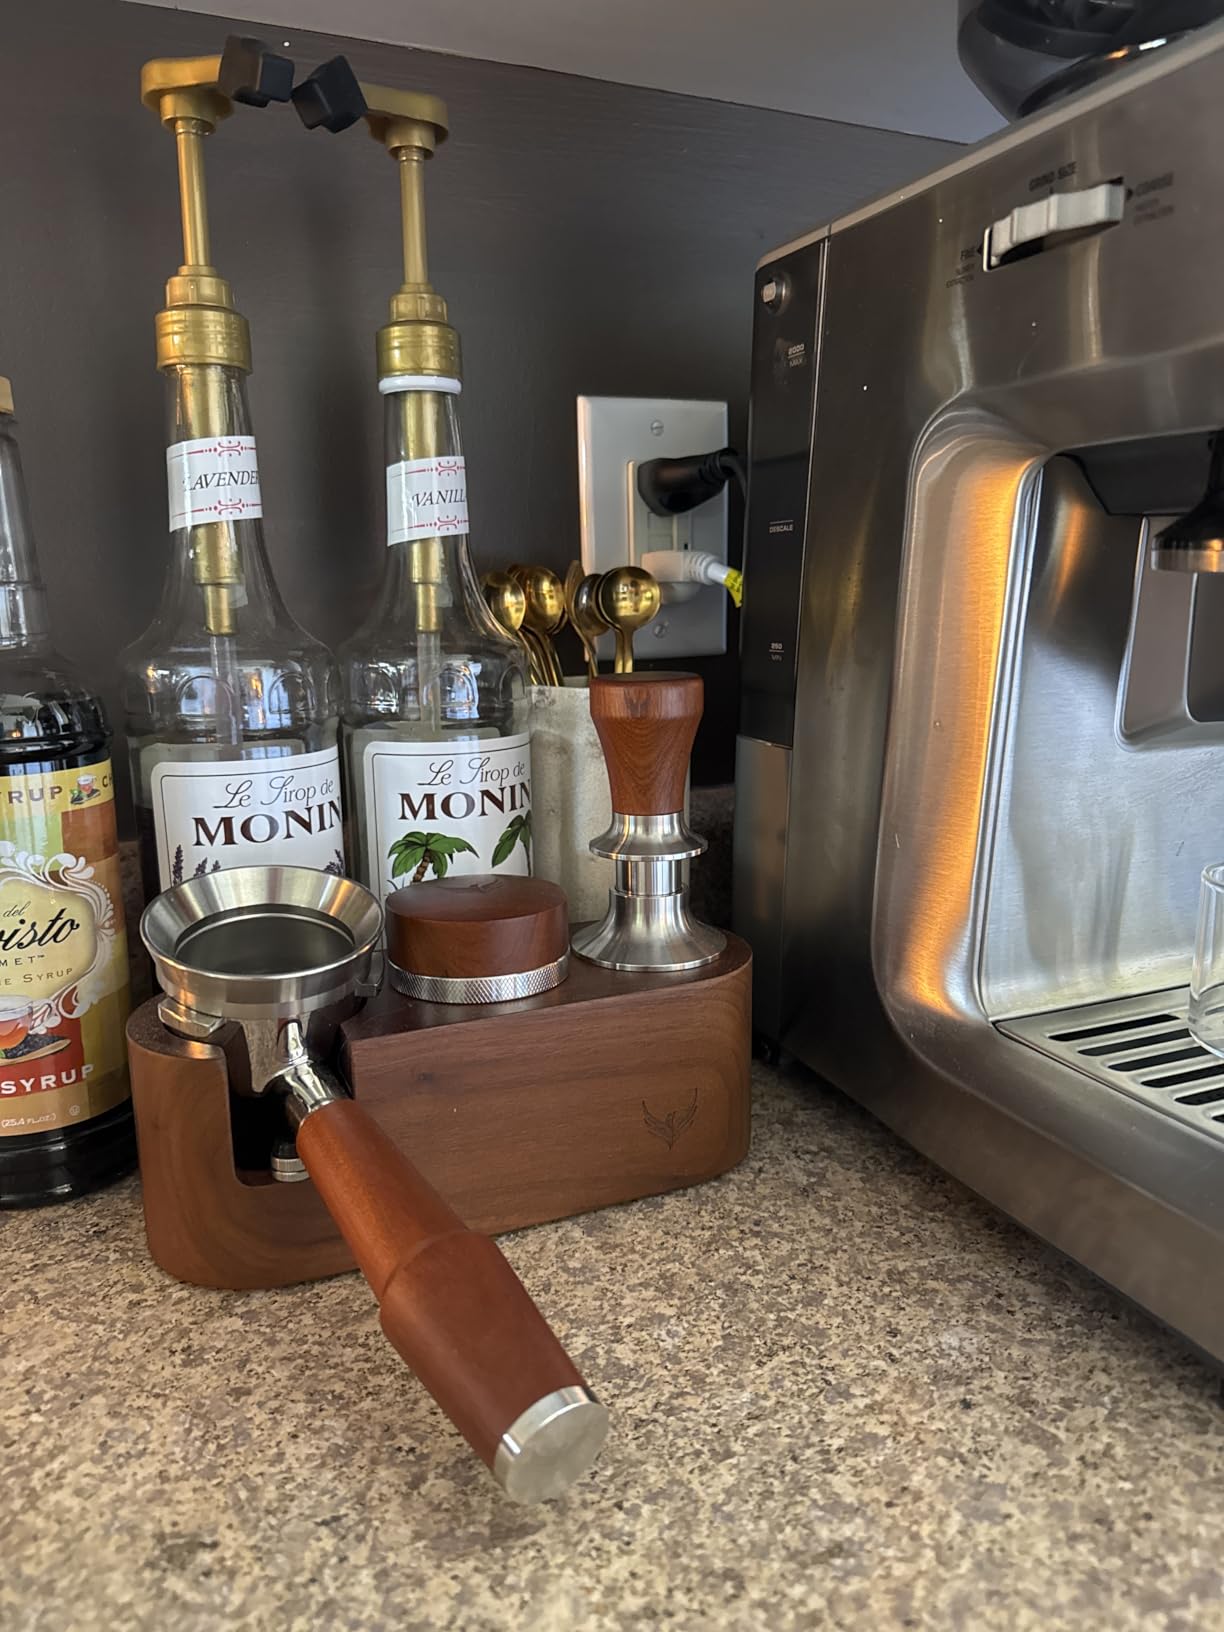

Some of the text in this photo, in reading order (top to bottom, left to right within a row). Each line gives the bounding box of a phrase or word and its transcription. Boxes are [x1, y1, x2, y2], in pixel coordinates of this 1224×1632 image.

[411, 488, 465, 507] VANILL
[769, 524, 794, 534] DESCALE
[416, 756, 526, 787] Le Sirop de
[0, 785, 63, 805] RUP
[213, 775, 334, 809] Le Sirop de
[3, 900, 32, 918] del
[23, 968, 73, 983] SYRUP
[1, 1064, 94, 1095] SYRUP
